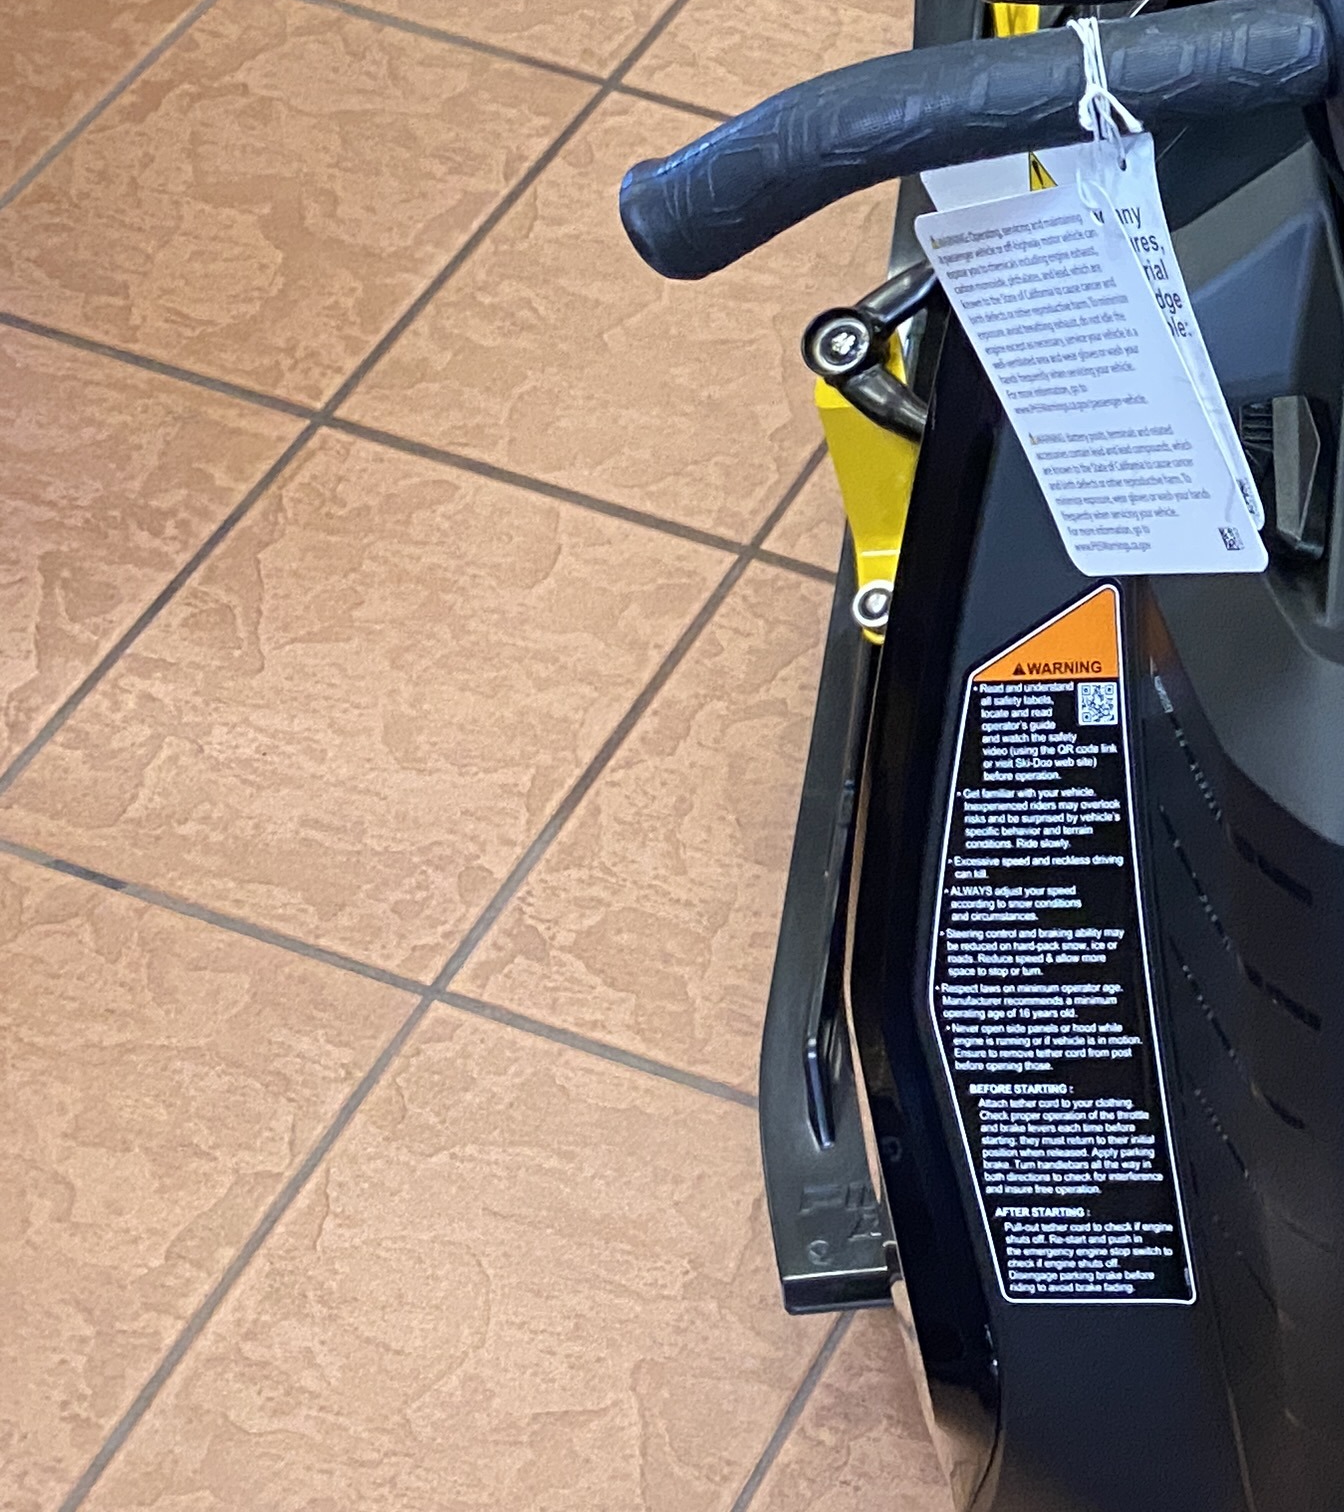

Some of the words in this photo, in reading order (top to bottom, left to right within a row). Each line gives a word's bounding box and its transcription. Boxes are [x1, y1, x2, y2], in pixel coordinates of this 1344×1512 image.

[1027, 661, 1102, 676] WARNING
[982, 745, 1008, 755] video
[1009, 745, 1038, 756] (using
[1039, 744, 1055, 754] the
[1056, 744, 1074, 753] QR
[1075, 743, 1099, 753] code
[1100, 743, 1117, 753] link
[983, 759, 993, 768] or
[994, 758, 1013, 767] visit
[1014, 758, 1052, 767] Ski-Doo
[1054, 757, 1074, 767] web
[1076, 757, 1097, 769] site)
[963, 788, 980, 798] Get
[981, 788, 1015, 797] familiar
[1016, 788, 1036, 797] with
[1037, 789, 1059, 799] your
[954, 856, 1000, 865] Excessive
[1001, 855, 1030, 867] speed
[1031, 855, 1050, 865] and
[1051, 855, 1090, 865] reckless
[1091, 855, 1124, 866] driving
[950, 885, 992, 895] ALWAYS
[994, 885, 1022, 897] adjust
[1023, 886, 1045, 897] your
[1046, 885, 1076, 896] speed
[969, 1083, 1012, 1093] BEFORE
[1013, 1084, 1067, 1093] STARTING
[995, 1207, 1030, 1216] AFTER
[1031, 1207, 1084, 1216] STARTING
